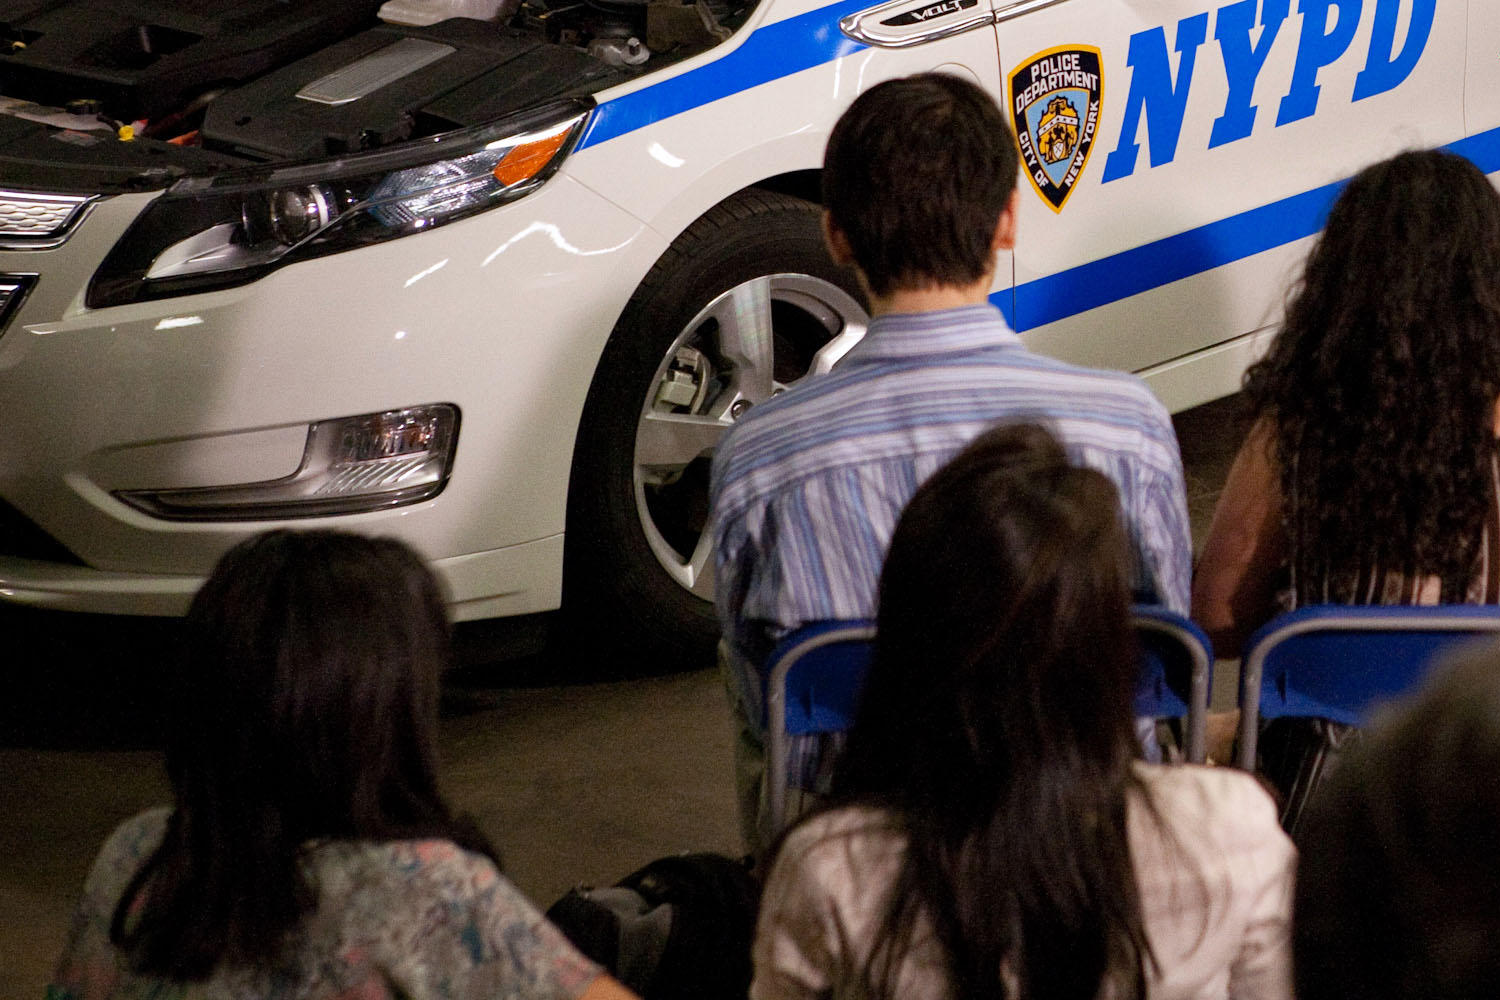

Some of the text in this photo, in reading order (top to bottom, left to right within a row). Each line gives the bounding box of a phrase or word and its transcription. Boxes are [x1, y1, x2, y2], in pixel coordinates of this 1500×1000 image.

[1031, 54, 1081, 83] POLICE
[1016, 71, 1098, 115] DEPARTMENT
[1018, 100, 1100, 188] CITY OF NEW YORK
